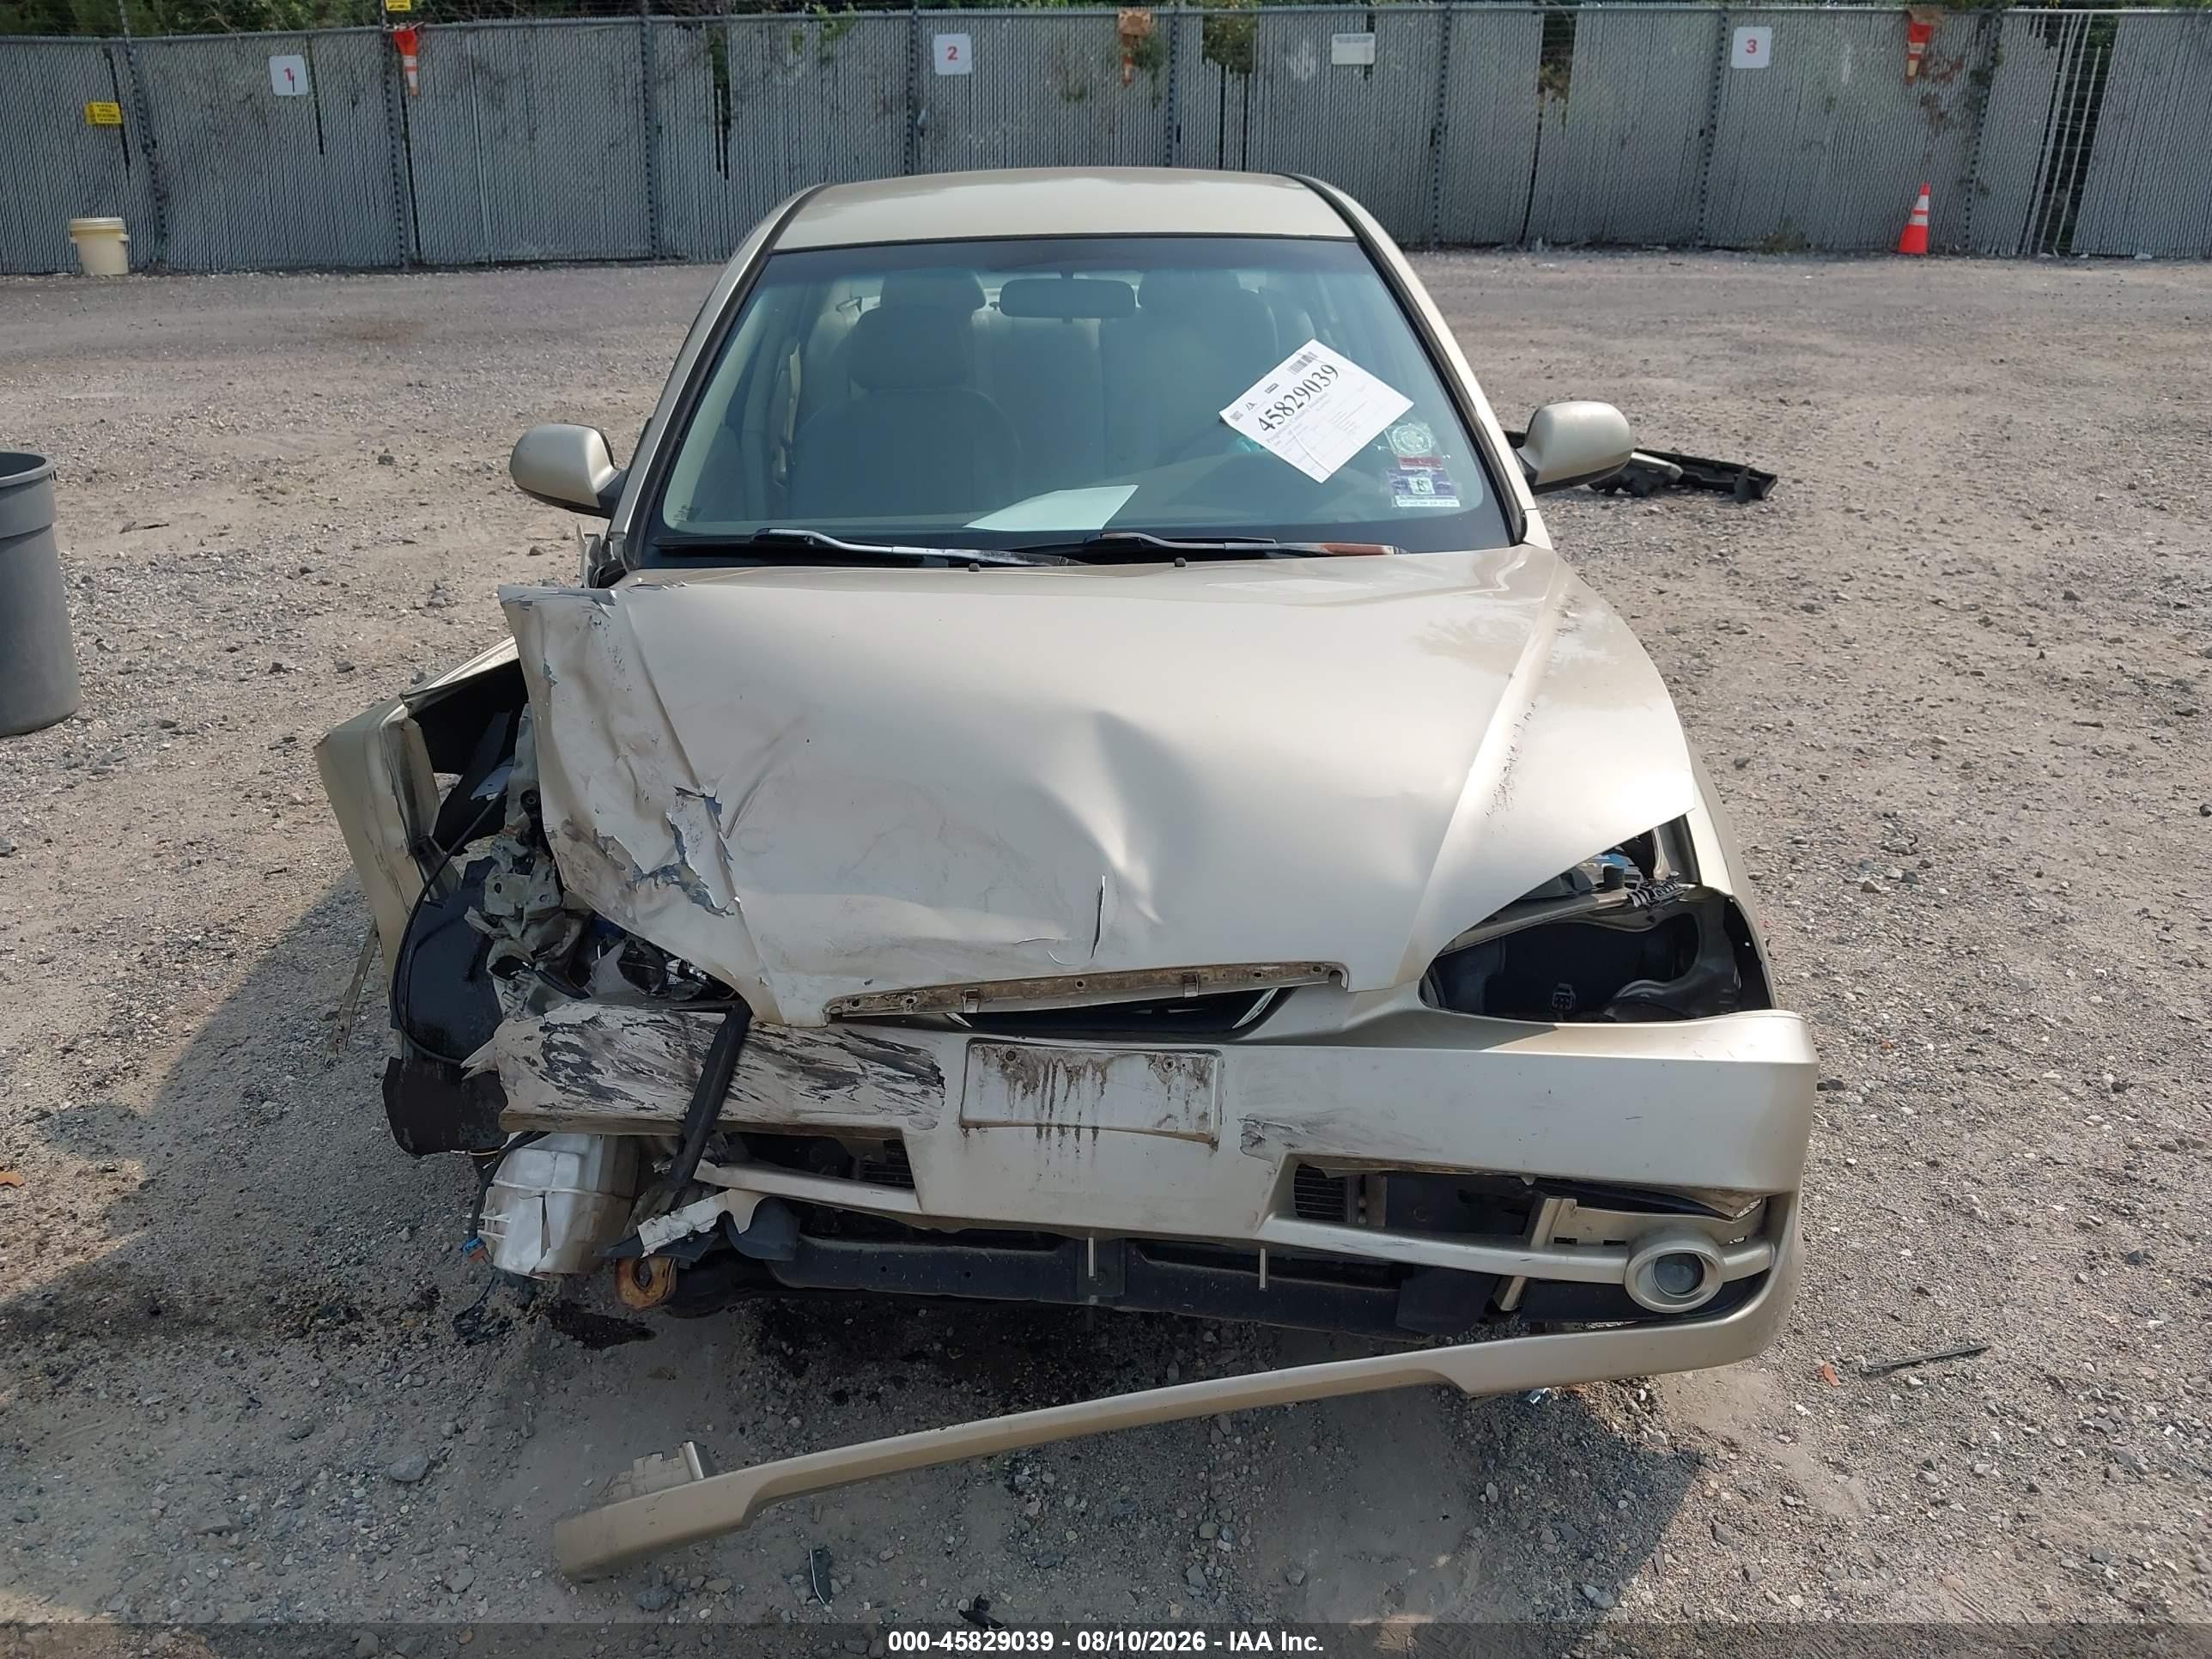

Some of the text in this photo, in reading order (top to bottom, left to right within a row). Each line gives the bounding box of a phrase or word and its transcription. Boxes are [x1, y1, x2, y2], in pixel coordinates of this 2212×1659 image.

[947, 46, 958, 61] 2
[1746, 39, 1758, 54] 3
[283, 67, 293, 82] 1
[1257, 363, 1339, 432] 45829039
